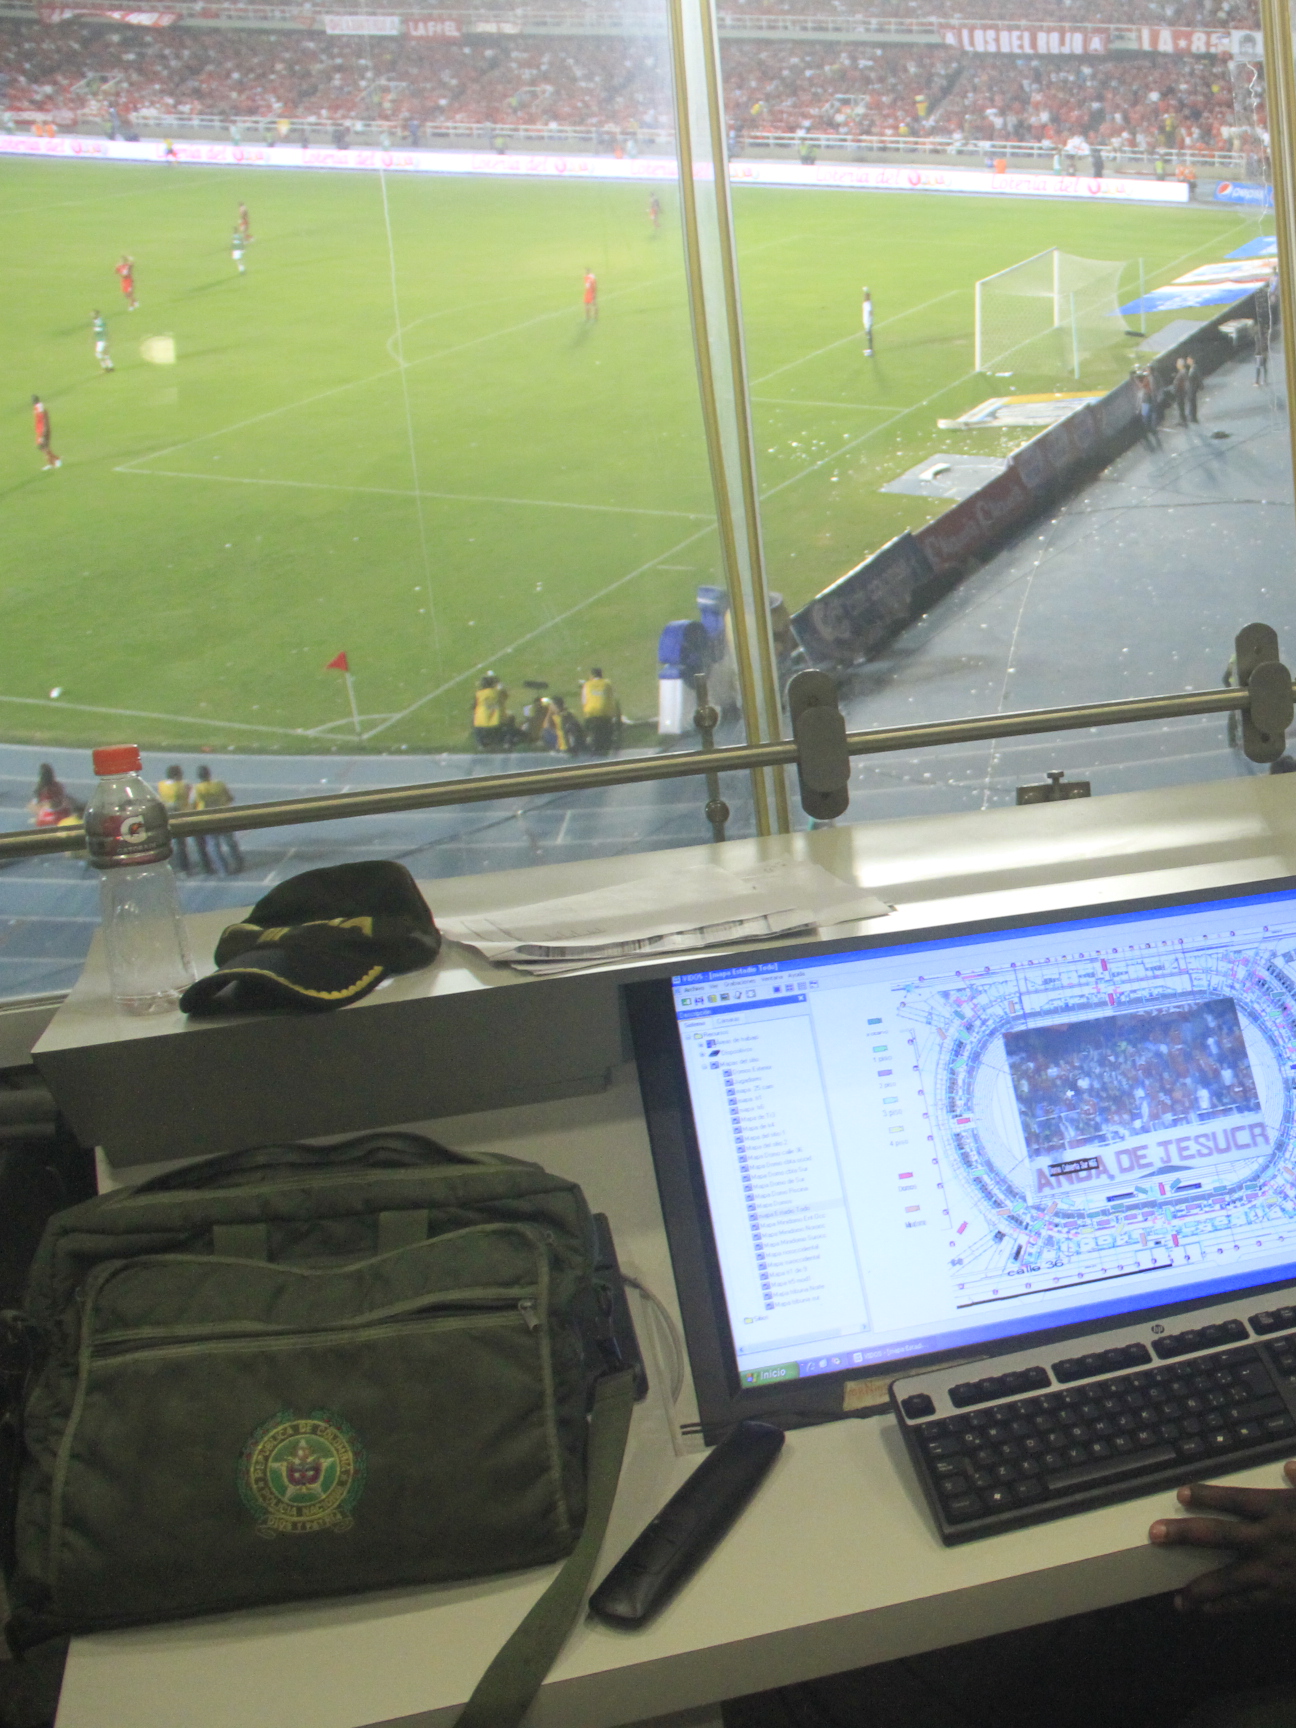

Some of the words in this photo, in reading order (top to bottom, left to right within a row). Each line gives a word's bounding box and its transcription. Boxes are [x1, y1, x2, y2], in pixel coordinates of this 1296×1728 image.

[961, 29, 997, 52] LOS
[1000, 30, 1035, 53] DEL
[1036, 31, 1084, 54] ROJO
[1140, 27, 1173, 52] LA
[1114, 1143, 1155, 1175] DE
[1157, 1121, 1271, 1165] JESUCR
[1007, 1264, 1041, 1277] calle
[1045, 1259, 1064, 1270] 36
[1151, 1324, 1165, 1334] hp
[760, 1367, 787, 1380] Inicio
